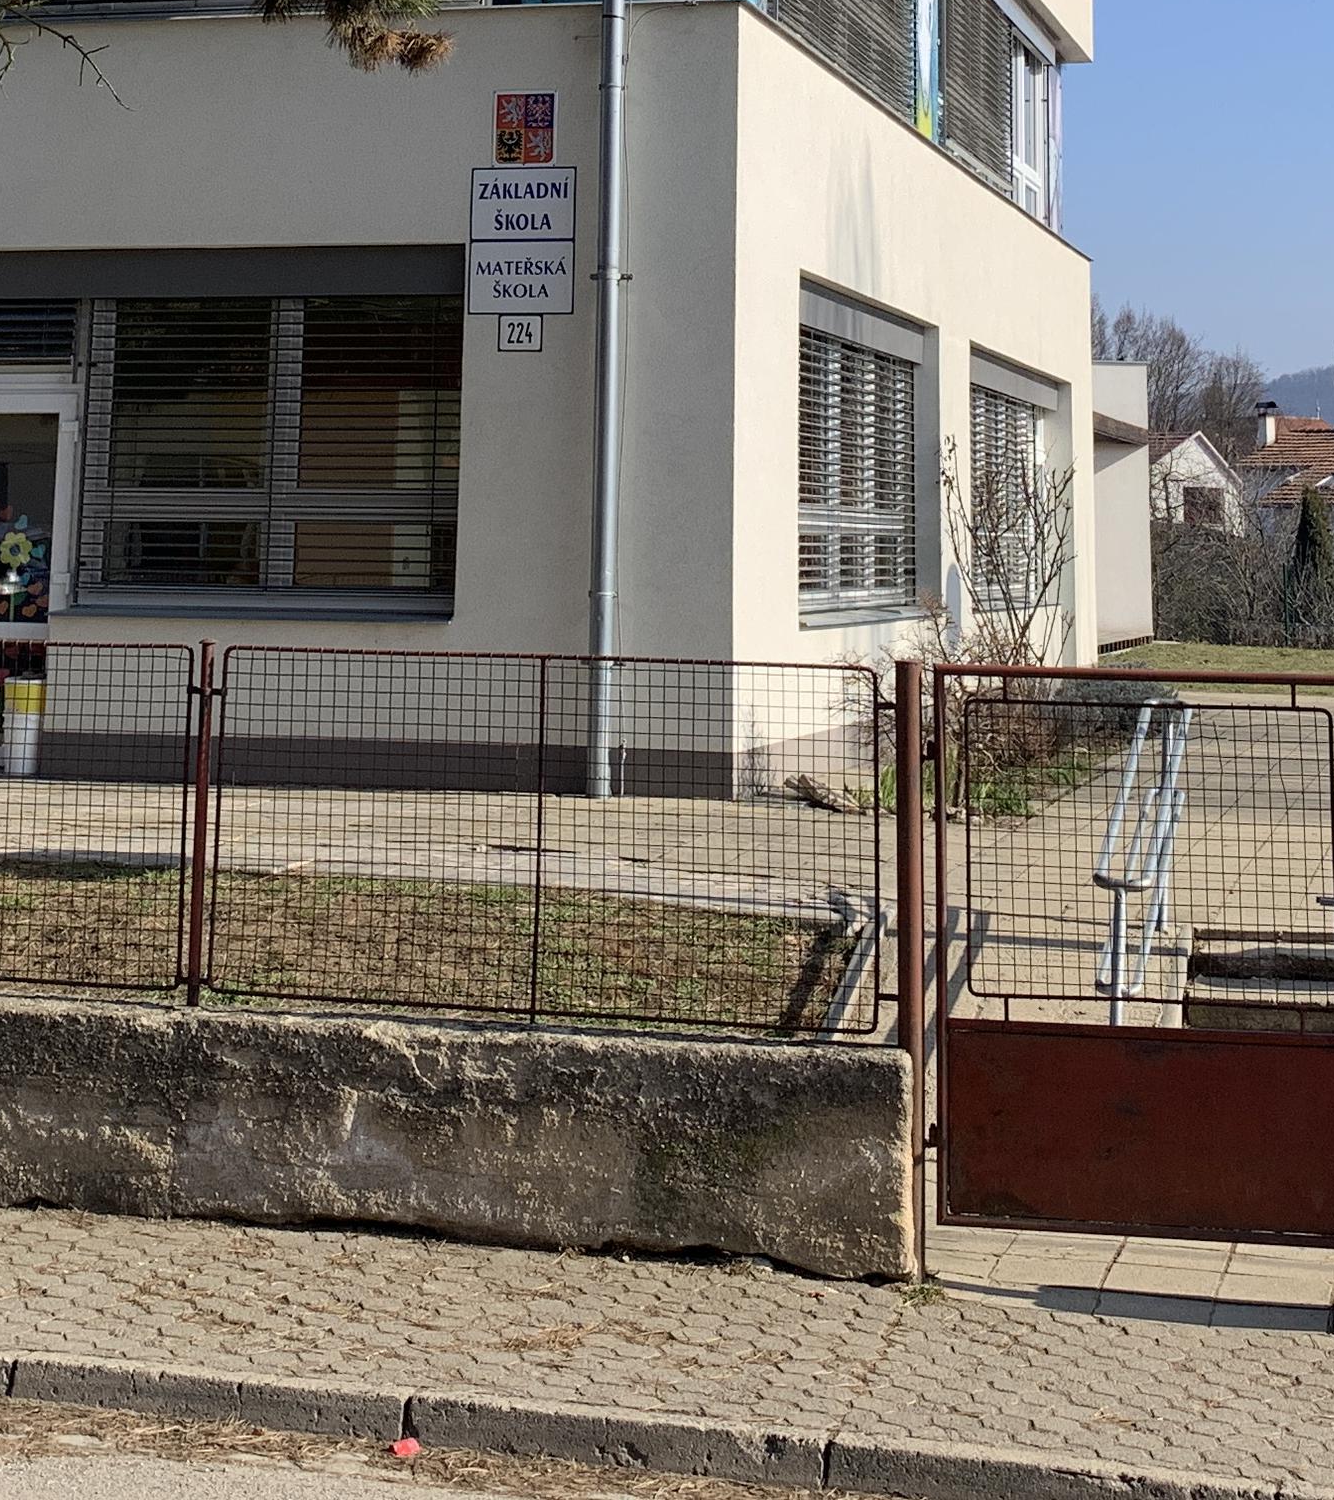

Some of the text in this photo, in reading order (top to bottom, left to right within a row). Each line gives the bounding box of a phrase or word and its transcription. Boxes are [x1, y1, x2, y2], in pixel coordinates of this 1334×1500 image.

[478, 177, 569, 200] ZÁKLADNÍ
[494, 209, 552, 231] ŠKOLA
[476, 257, 567, 276] MATEŘSKÁ
[492, 279, 549, 298] ŠKOLA
[507, 322, 533, 344] 224
